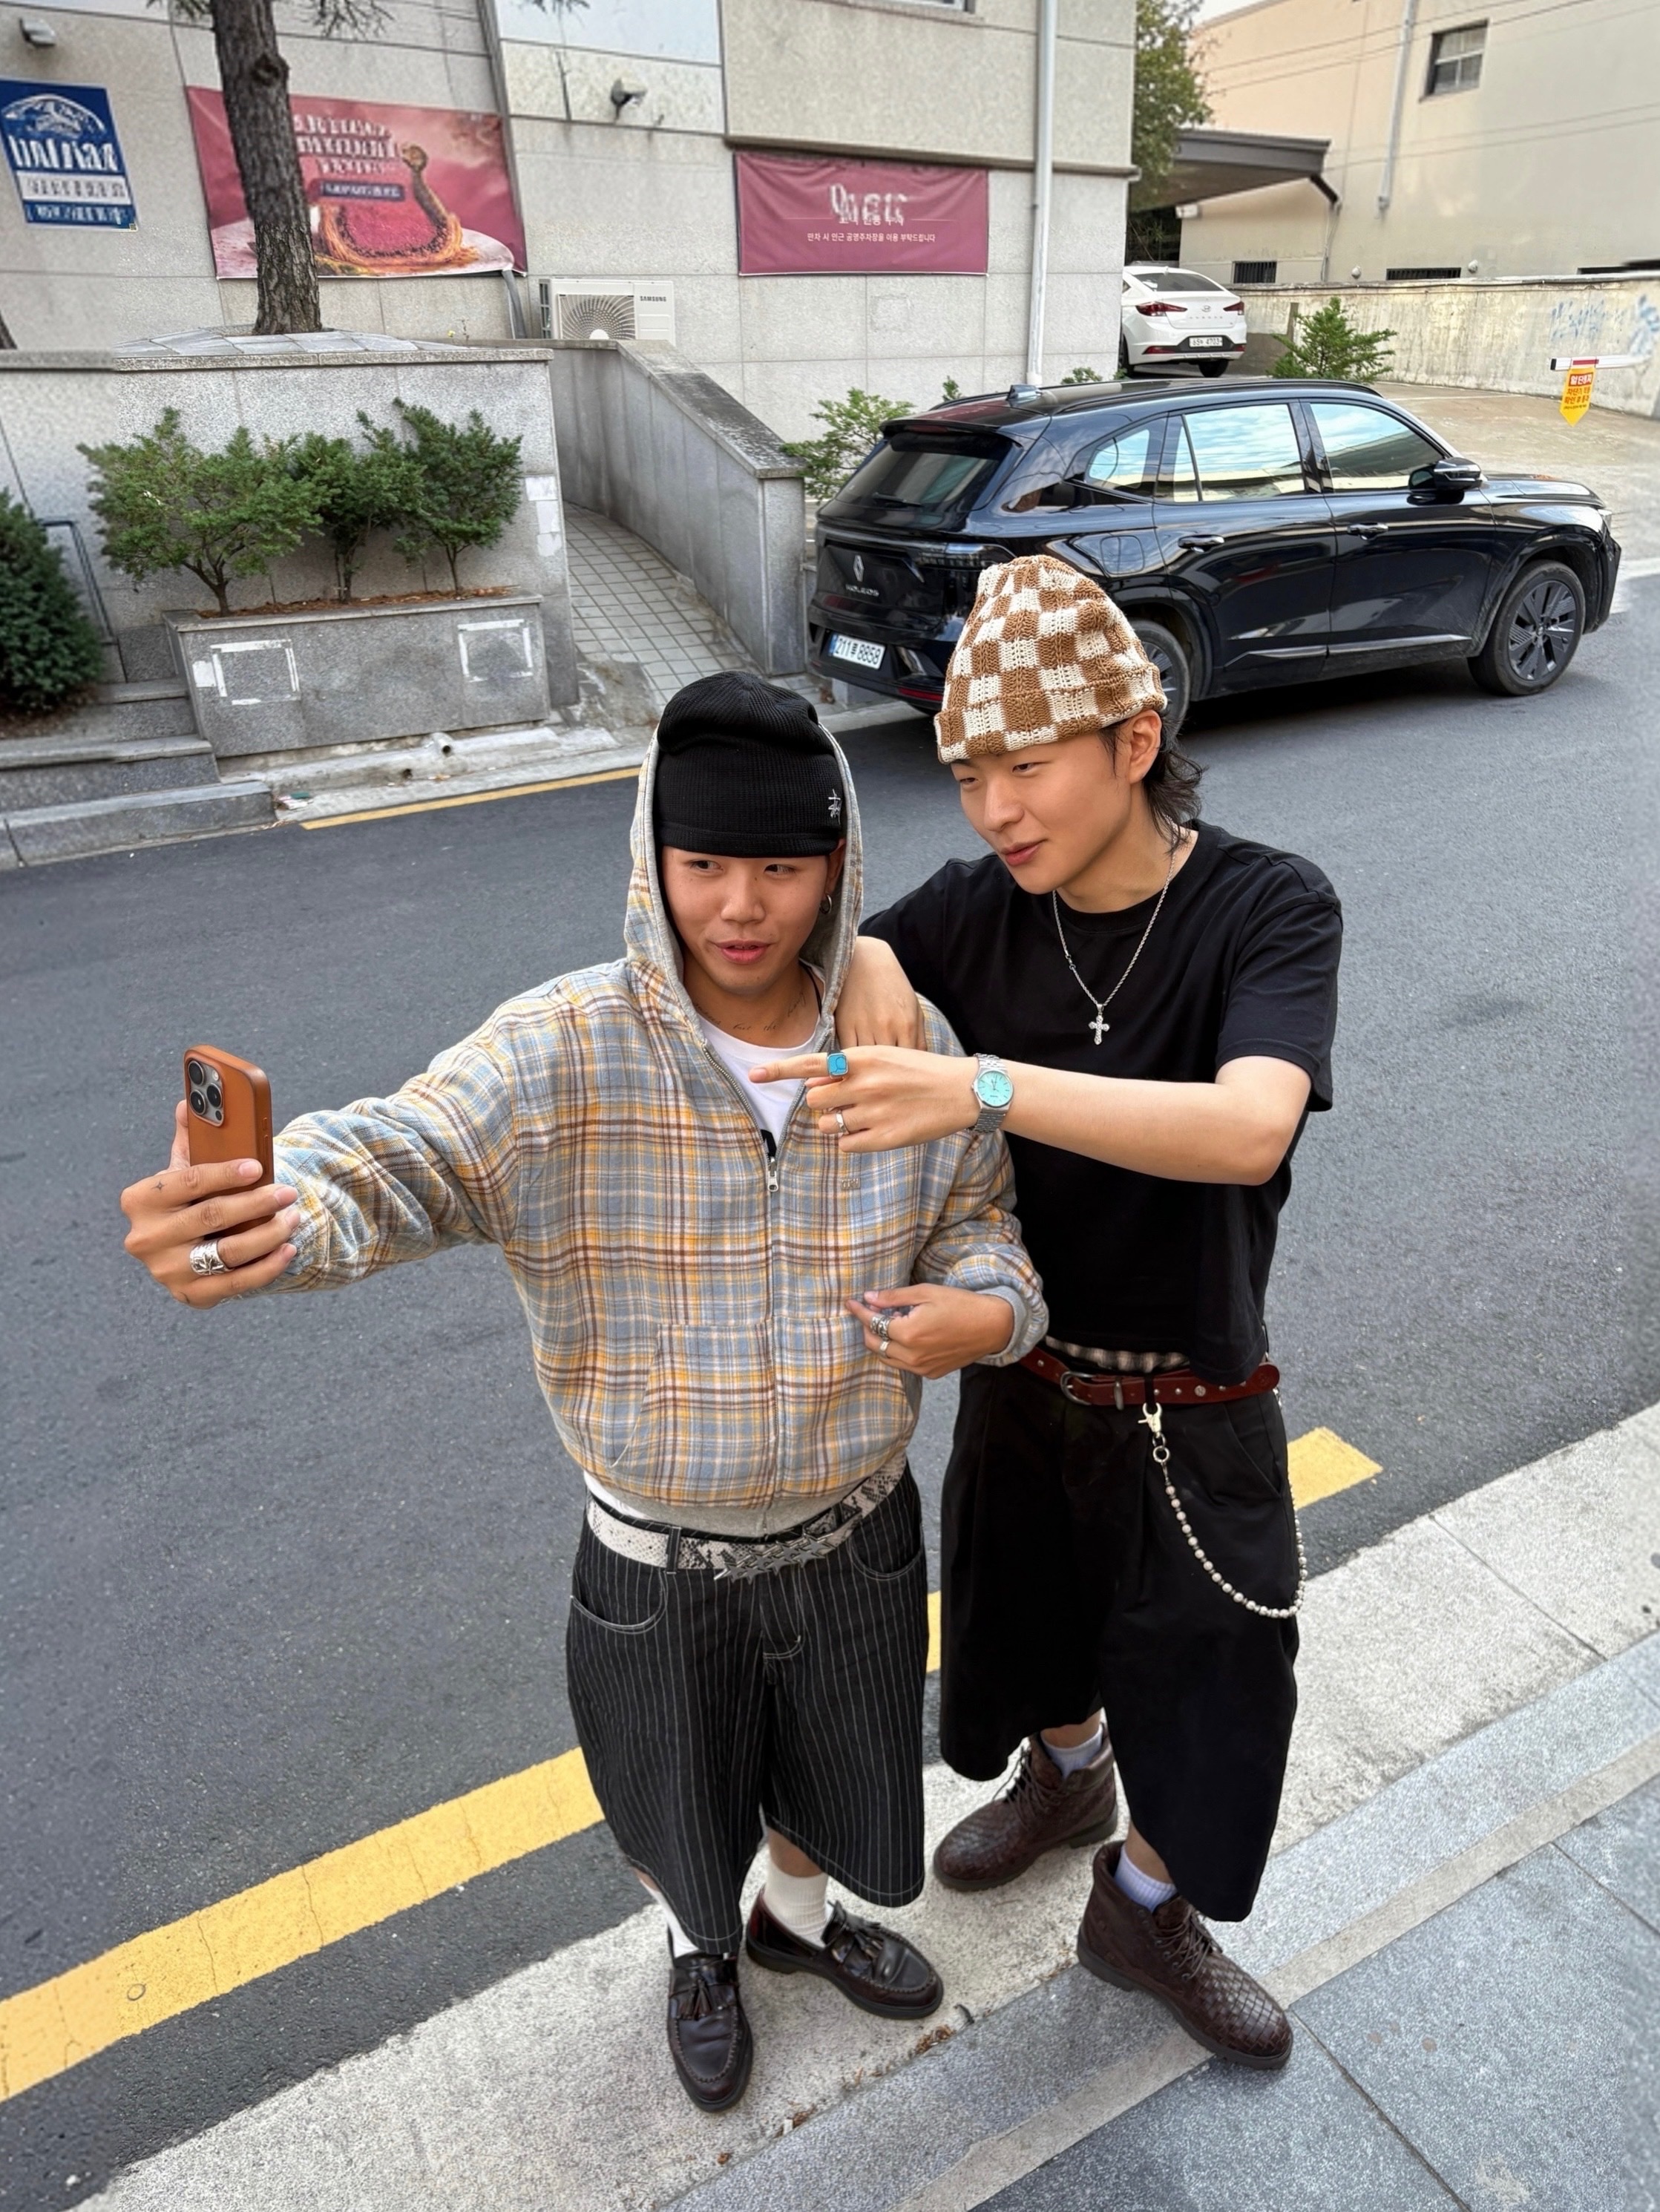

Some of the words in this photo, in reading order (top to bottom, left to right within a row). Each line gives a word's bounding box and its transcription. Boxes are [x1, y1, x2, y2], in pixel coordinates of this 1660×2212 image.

[807, 233, 821, 242] 만차
[822, 233, 830, 242] 시
[831, 233, 844, 242] 인근
[846, 233, 885, 242] 공영주차장을
[886, 233, 899, 243] 이용
[900, 234, 936, 243] 부탁드립니다
